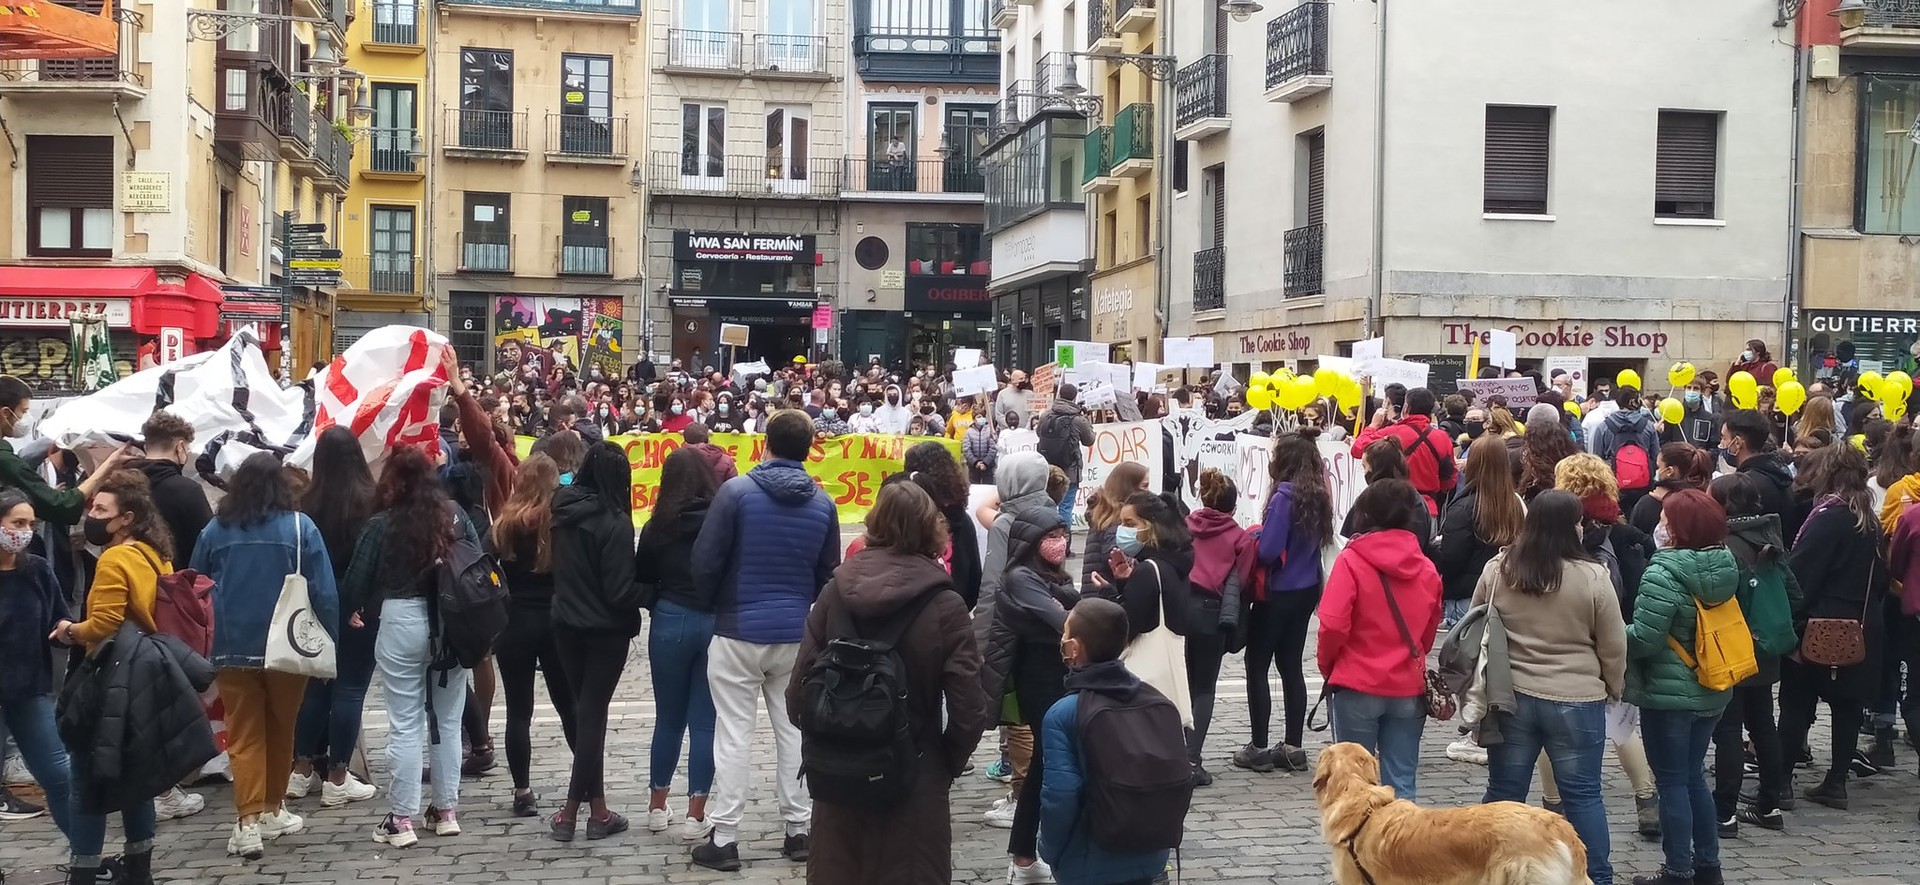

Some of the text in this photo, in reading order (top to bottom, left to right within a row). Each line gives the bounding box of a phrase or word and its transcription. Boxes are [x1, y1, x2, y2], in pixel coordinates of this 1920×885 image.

[723, 238, 750, 249] SAN
[753, 236, 804, 251] FERMÍN!
[695, 252, 794, 261] Cervecería Restaurante
[867, 289, 876, 303] 2
[1094, 282, 1132, 318] Kafetegia
[464, 319, 473, 330] 6
[1240, 331, 1310, 355] The Cookie Shop
[1443, 323, 1668, 353] The Cookie Shop
[839, 438, 853, 459] Y
[1087, 467, 1098, 481] DE
[835, 471, 873, 506] SE
